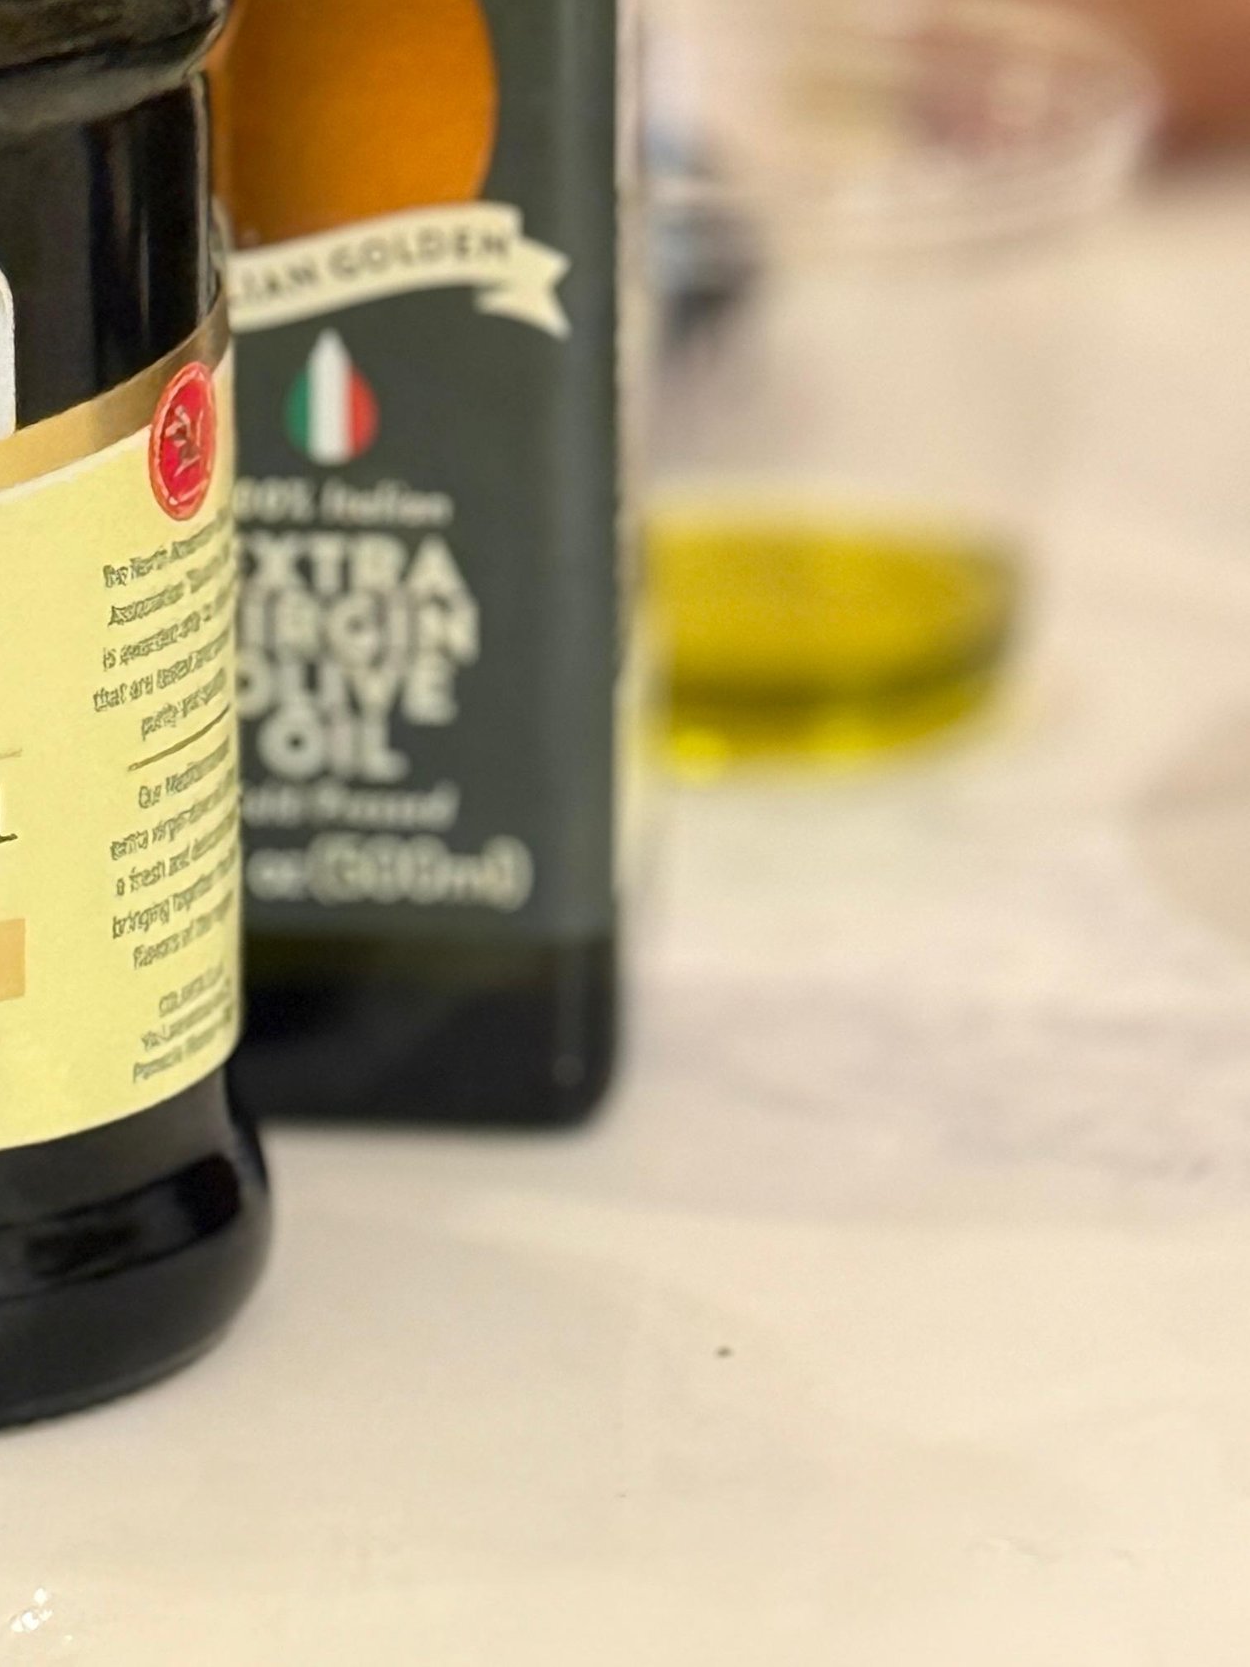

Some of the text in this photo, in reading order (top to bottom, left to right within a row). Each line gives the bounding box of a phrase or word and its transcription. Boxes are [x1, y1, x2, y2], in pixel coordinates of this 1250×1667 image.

[327, 226, 509, 282] GOLDEN
[319, 477, 454, 527] Italian
[236, 530, 474, 598] XTRA
[237, 588, 480, 664] IRGIN
[258, 710, 410, 783] OIL
